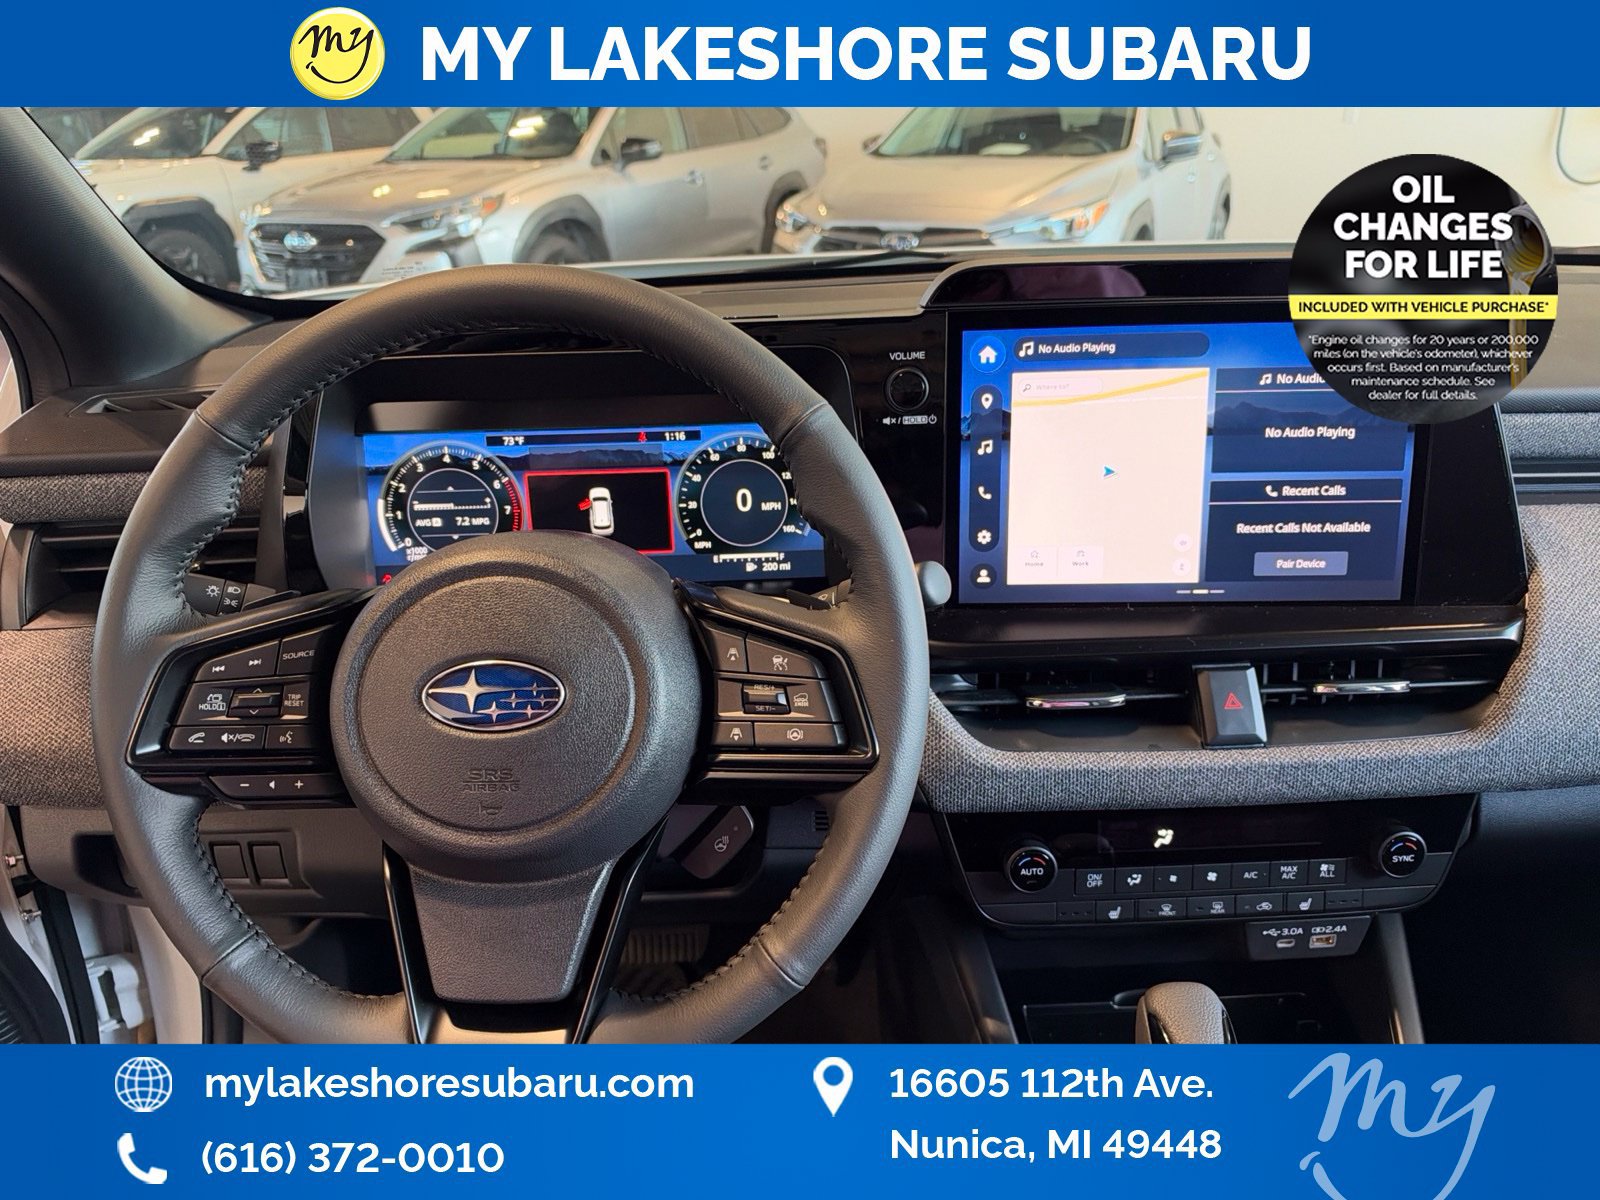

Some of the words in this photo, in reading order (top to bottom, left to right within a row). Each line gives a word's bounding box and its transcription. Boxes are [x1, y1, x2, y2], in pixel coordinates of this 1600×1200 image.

[1038, 344, 1052, 354] No
[1053, 342, 1081, 354] Audio
[1082, 342, 1116, 355] Playing
[889, 351, 926, 360] VOLUME
[1276, 374, 1294, 385] No
[664, 431, 686, 442] 1:16
[1264, 427, 1281, 438] No
[1282, 426, 1315, 438] Audio
[1316, 425, 1356, 439] Playing
[736, 444, 747, 453] 80
[442, 454, 451, 463] 4
[709, 453, 720, 462] 60
[762, 451, 775, 460] 100
[416, 463, 424, 473] 3
[471, 461, 480, 471] 5
[691, 474, 702, 482] 40
[781, 472, 792, 480] 12
[398, 483, 406, 493] 2
[493, 480, 501, 490] 6
[1281, 485, 1319, 497] Recent
[1320, 484, 1347, 496] Calls
[735, 488, 753, 513] 0
[503, 505, 512, 515] 7
[687, 501, 698, 510] 20
[761, 501, 782, 512] MPH
[395, 511, 402, 520] 1
[415, 519, 431, 528] AVG
[455, 516, 471, 526] 7.2
[472, 517, 490, 526] MPG
[782, 525, 796, 534] 160
[1236, 523, 1274, 534] Recent
[1274, 522, 1301, 534] Calls
[1301, 522, 1322, 533] Not
[1322, 521, 1372, 533] Available
[696, 528, 703, 537] 0
[404, 537, 412, 547] 0
[694, 541, 712, 550] MPH
[762, 562, 779, 571] 200
[1276, 559, 1295, 569] Pair
[1296, 558, 1327, 569] Device
[282, 649, 316, 661] SOURCE
[468, 768, 513, 781] SRS
[462, 783, 521, 793] AIRBAG
[1392, 855, 1415, 863] SYNC
[1020, 868, 1044, 876] AUTO
[1280, 865, 1298, 873] MAX
[1087, 873, 1103, 881] ON/
[1281, 872, 1296, 880] A/C
[1320, 870, 1335, 878] ALL
[1086, 880, 1103, 888] OFF
[1281, 927, 1304, 936] 3.0A
[1325, 925, 1348, 934] 2.4A
